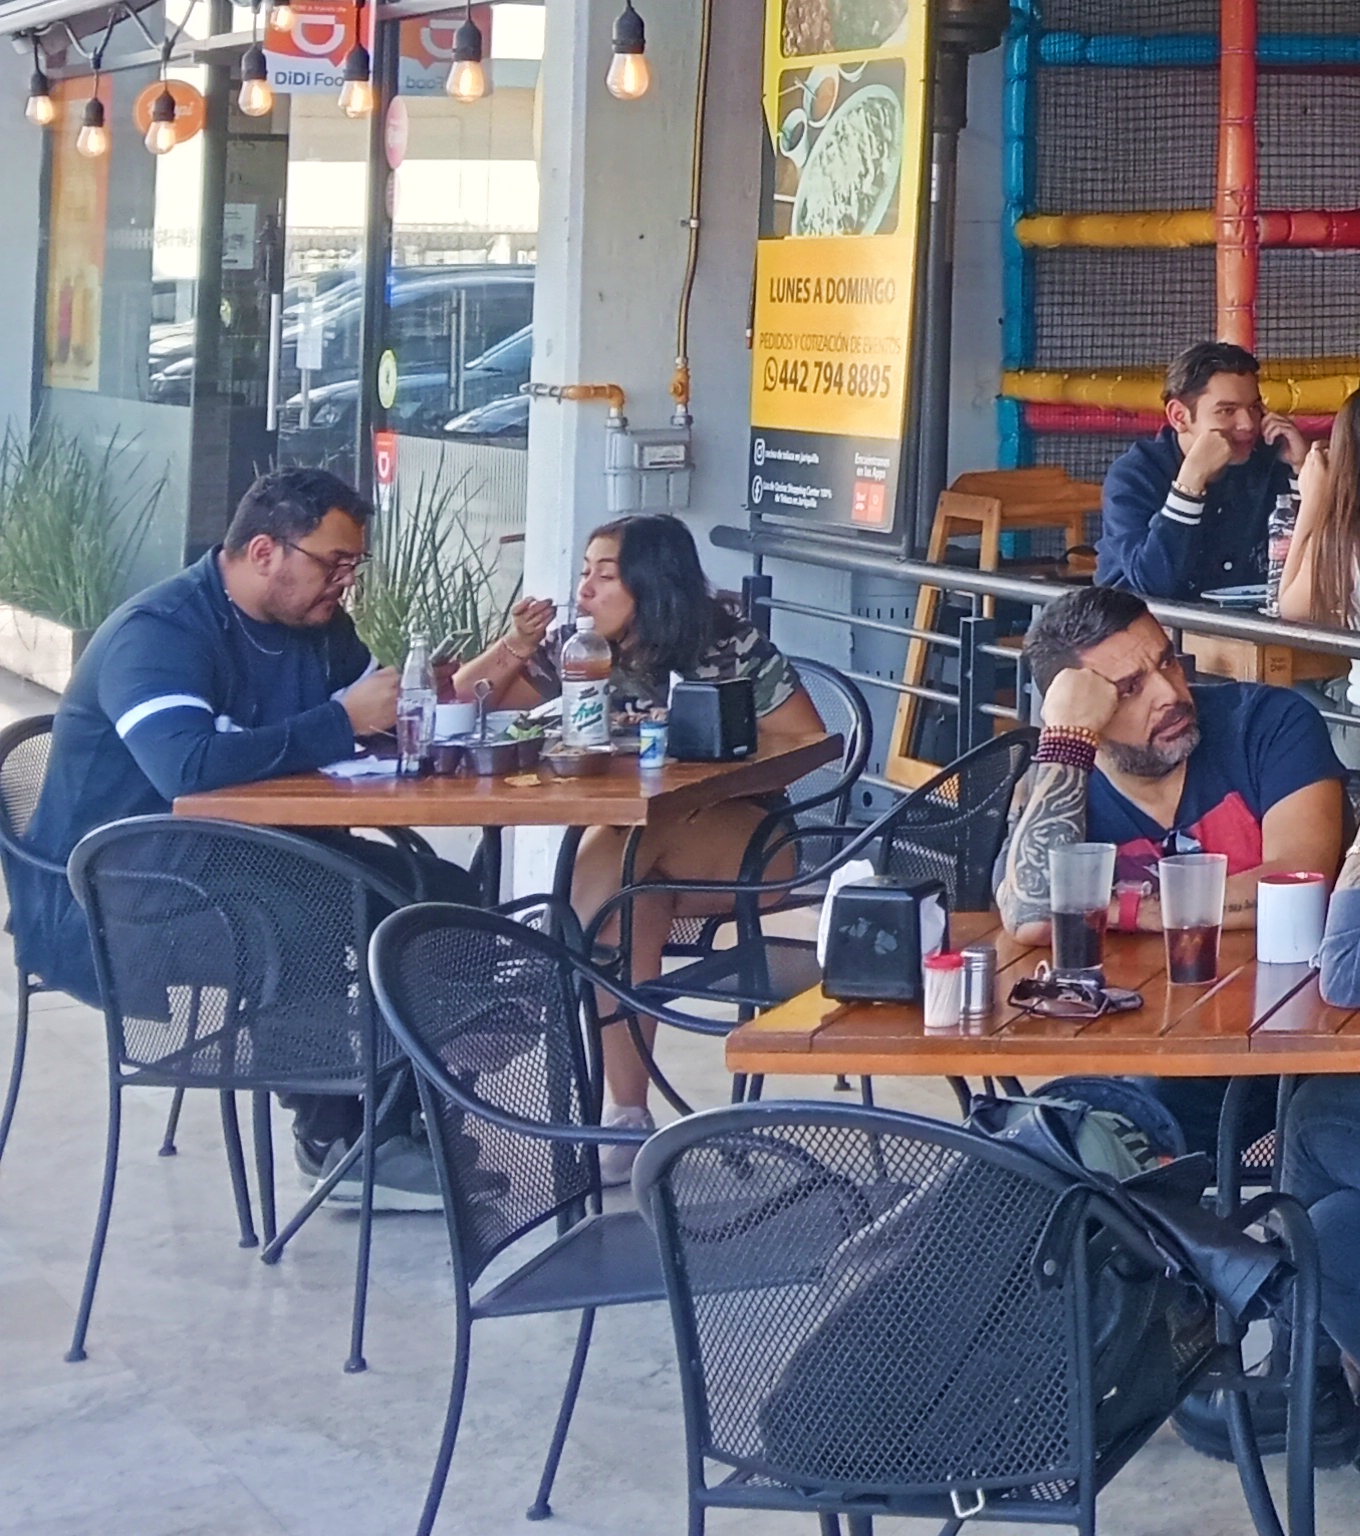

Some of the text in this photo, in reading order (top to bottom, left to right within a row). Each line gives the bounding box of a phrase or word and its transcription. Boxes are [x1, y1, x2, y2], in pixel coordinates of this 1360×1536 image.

[274, 70, 346, 86] DiDi Foo
[769, 277, 896, 305] LUNES A DOMINGO
[778, 359, 892, 399] 442 794 8895
